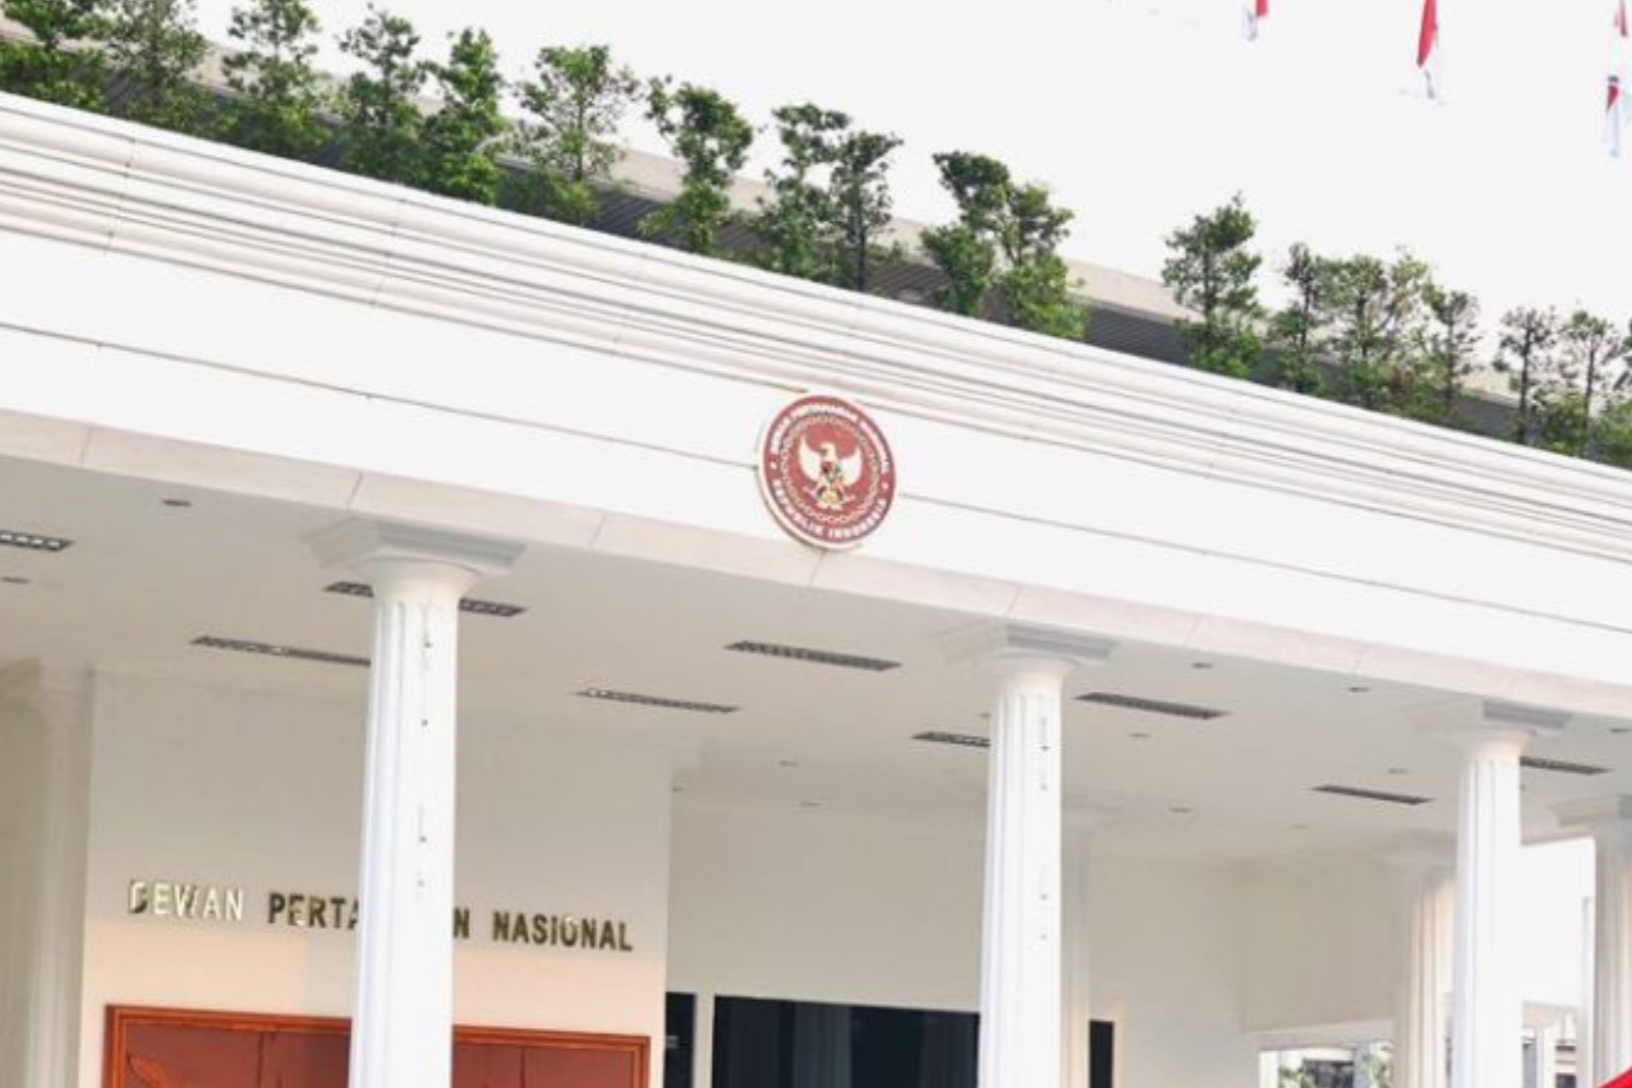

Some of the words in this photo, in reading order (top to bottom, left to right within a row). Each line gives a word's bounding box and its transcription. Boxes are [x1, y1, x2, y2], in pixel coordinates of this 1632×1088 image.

[129, 880, 244, 922] DEWAN
[266, 892, 470, 940] PERTAN
[493, 911, 634, 952] NASIONAL
